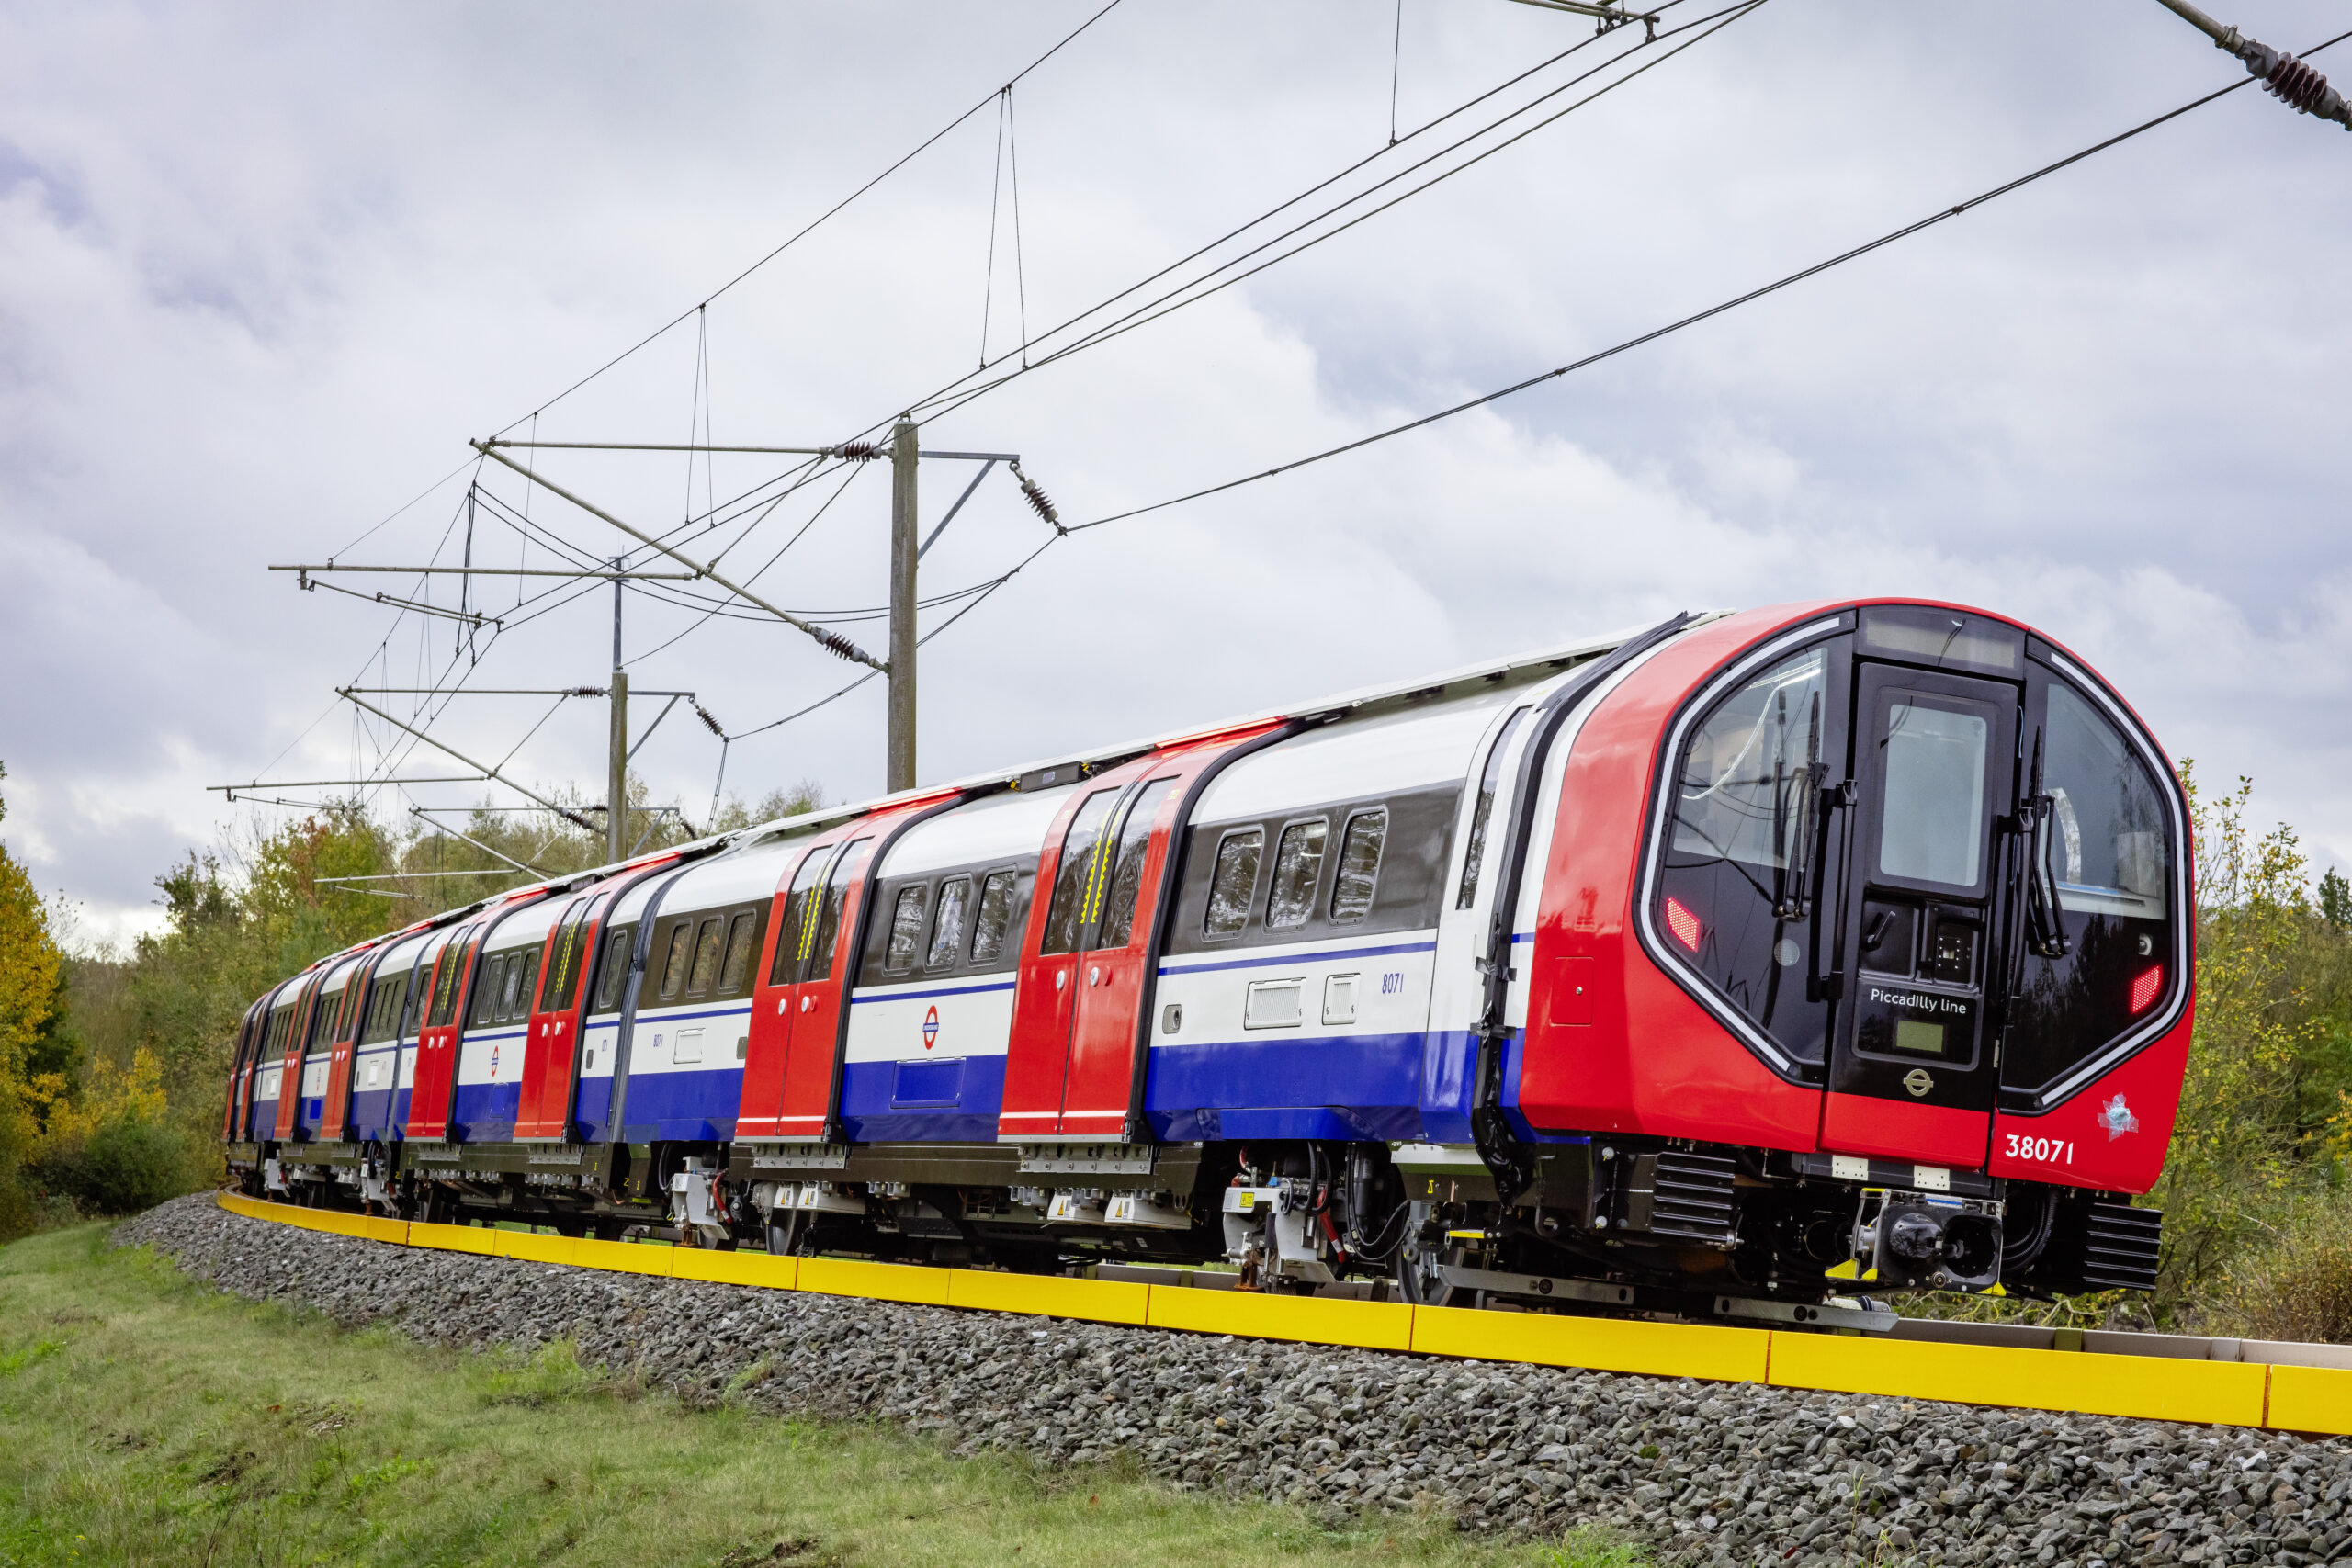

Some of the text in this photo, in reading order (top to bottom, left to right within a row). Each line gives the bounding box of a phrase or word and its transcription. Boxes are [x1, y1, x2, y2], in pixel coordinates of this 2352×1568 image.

[1382, 973, 1404, 994] 8071
[1871, 988, 1967, 1014] Piccadilly line
[2005, 1134, 2074, 1165] 38071
